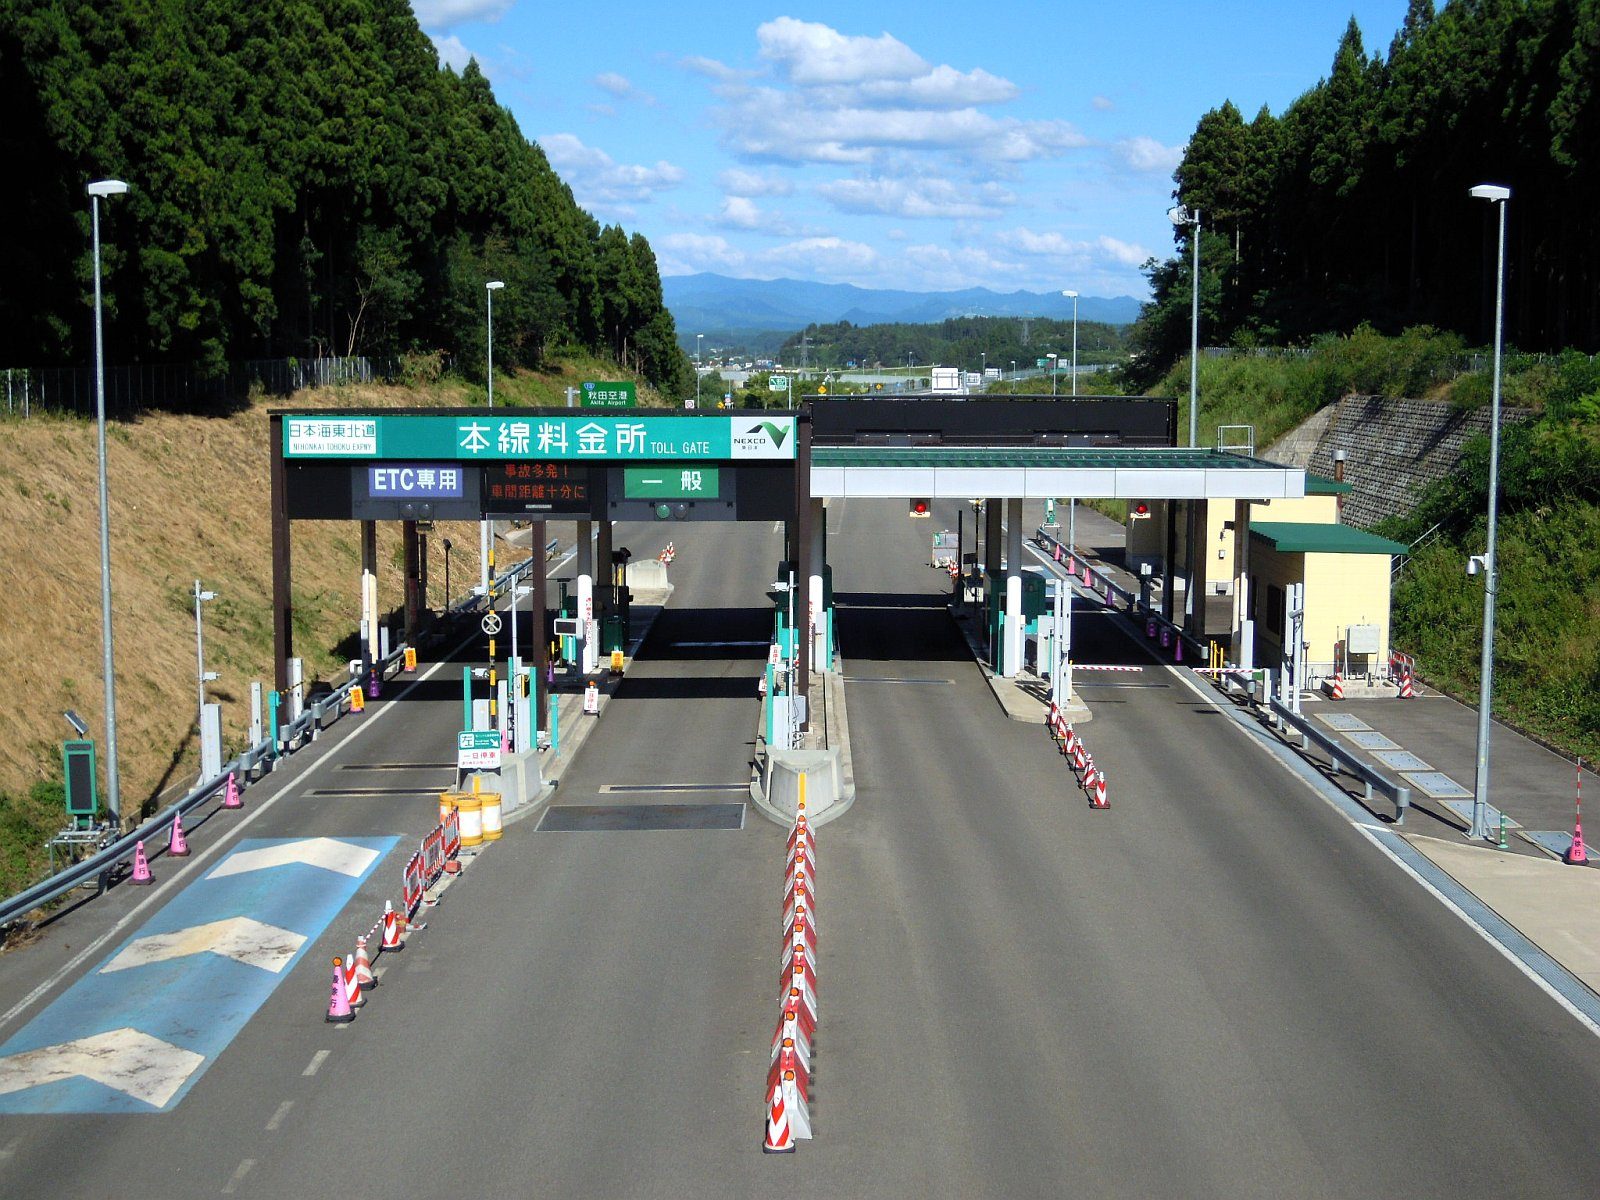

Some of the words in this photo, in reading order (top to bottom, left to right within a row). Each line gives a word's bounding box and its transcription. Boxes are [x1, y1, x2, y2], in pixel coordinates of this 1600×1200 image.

[588, 391, 627, 400] 秋田空港
[289, 423, 375, 438] 日本海東北道
[459, 421, 647, 454] 本線料金所
[293, 443, 324, 451] NIHONKAI
[326, 443, 351, 451] TOHOKU
[352, 443, 372, 451] EXPWY
[651, 441, 677, 454] TOLL
[682, 441, 710, 454] GATE
[374, 468, 457, 491] ETC専用
[492, 484, 585, 499] 車間距離十分に
